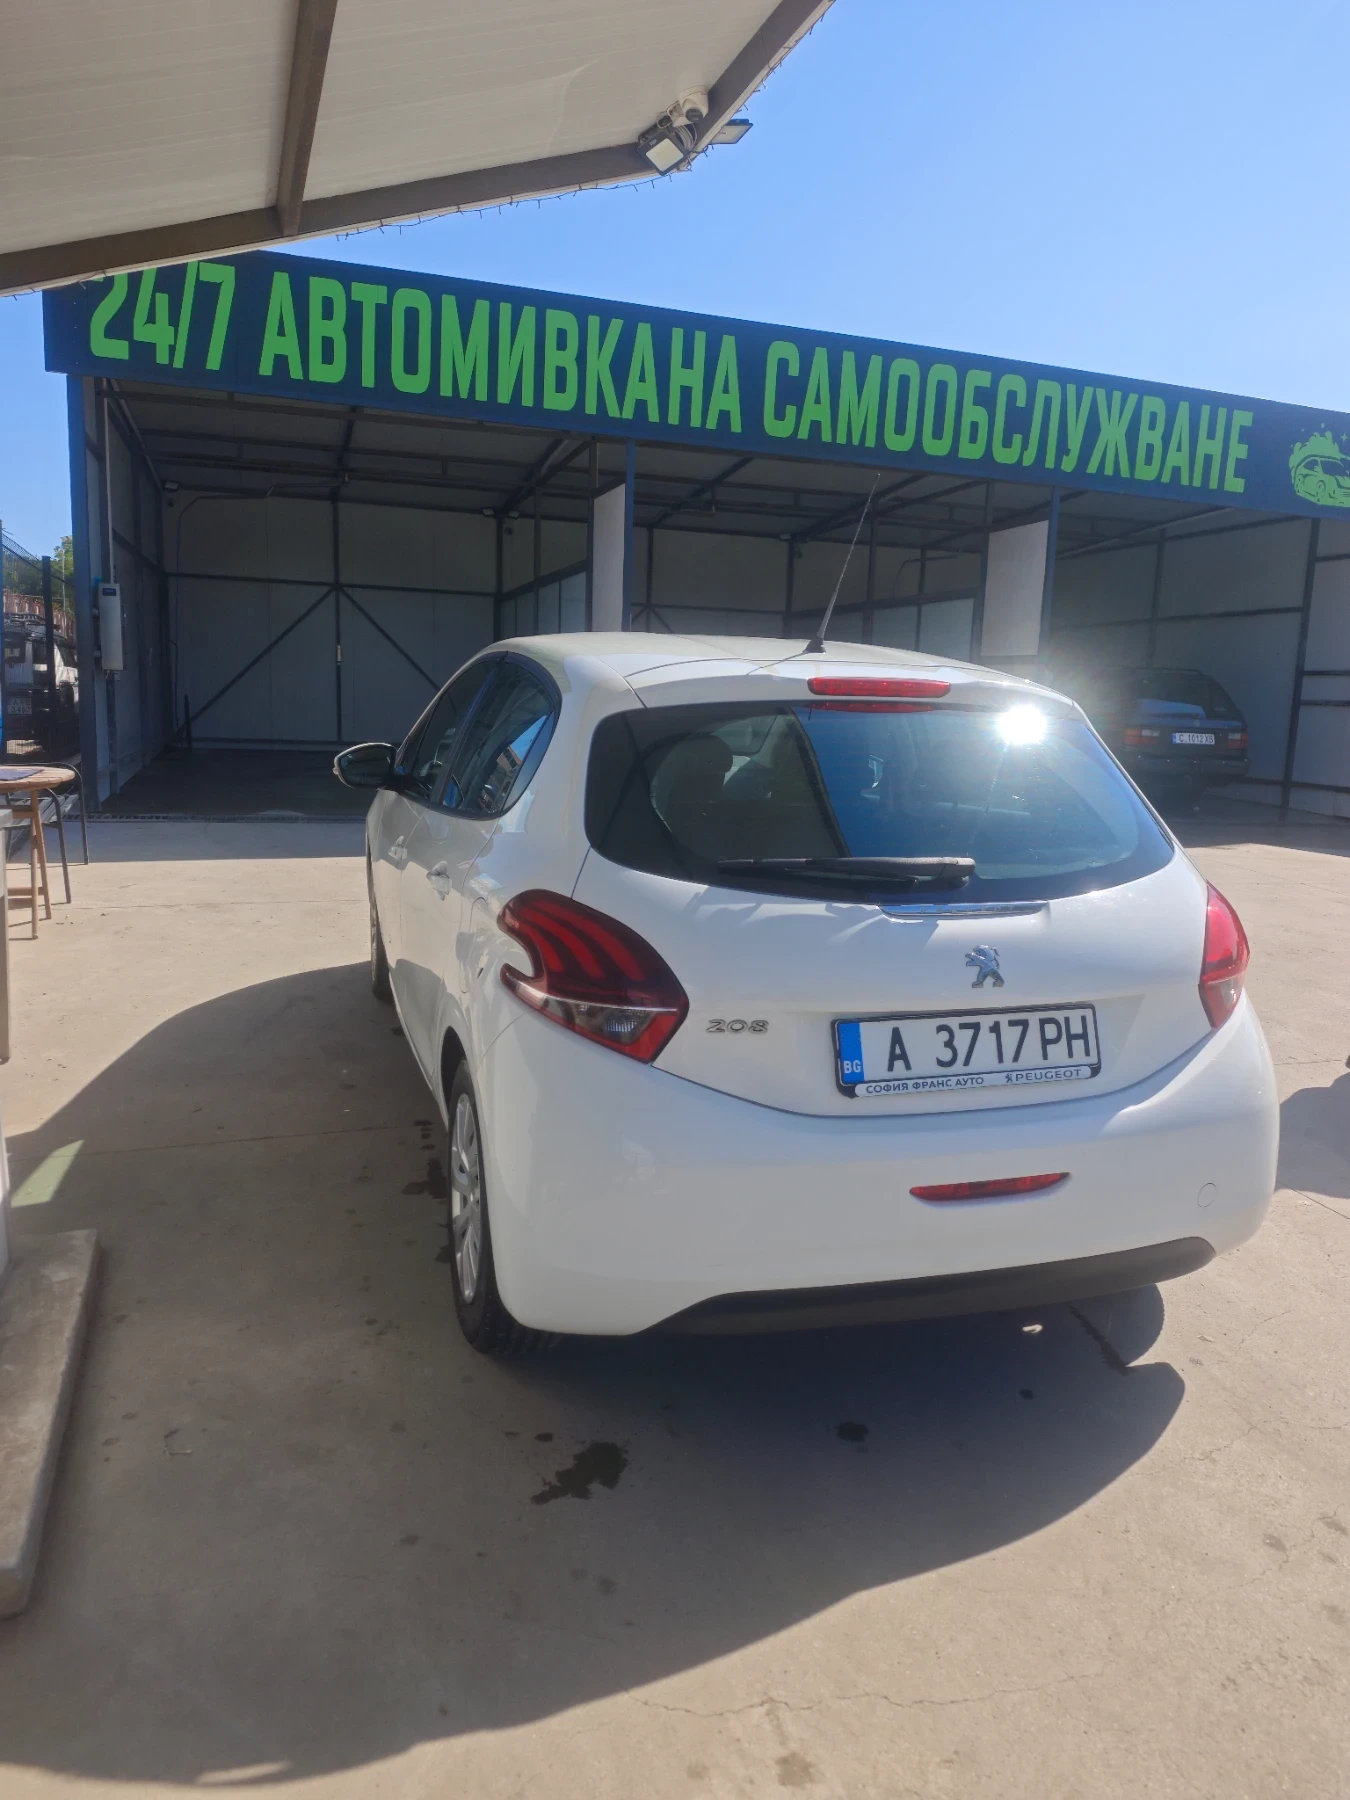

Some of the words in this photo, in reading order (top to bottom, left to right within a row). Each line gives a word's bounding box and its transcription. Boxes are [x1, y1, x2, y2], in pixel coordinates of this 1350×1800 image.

[91, 260, 235, 370] 24/7
[764, 341, 1253, 493] САМООБСЛУЖВАНЕ
[706, 1019, 769, 1034] 208
[843, 1060, 861, 1073] BG
[1015, 1069, 1082, 1082] PEUGEOT
[866, 1083, 909, 1094] СОФИЯ
[912, 1079, 952, 1090] ФРАНС
[955, 1077, 984, 1087] АУТО
